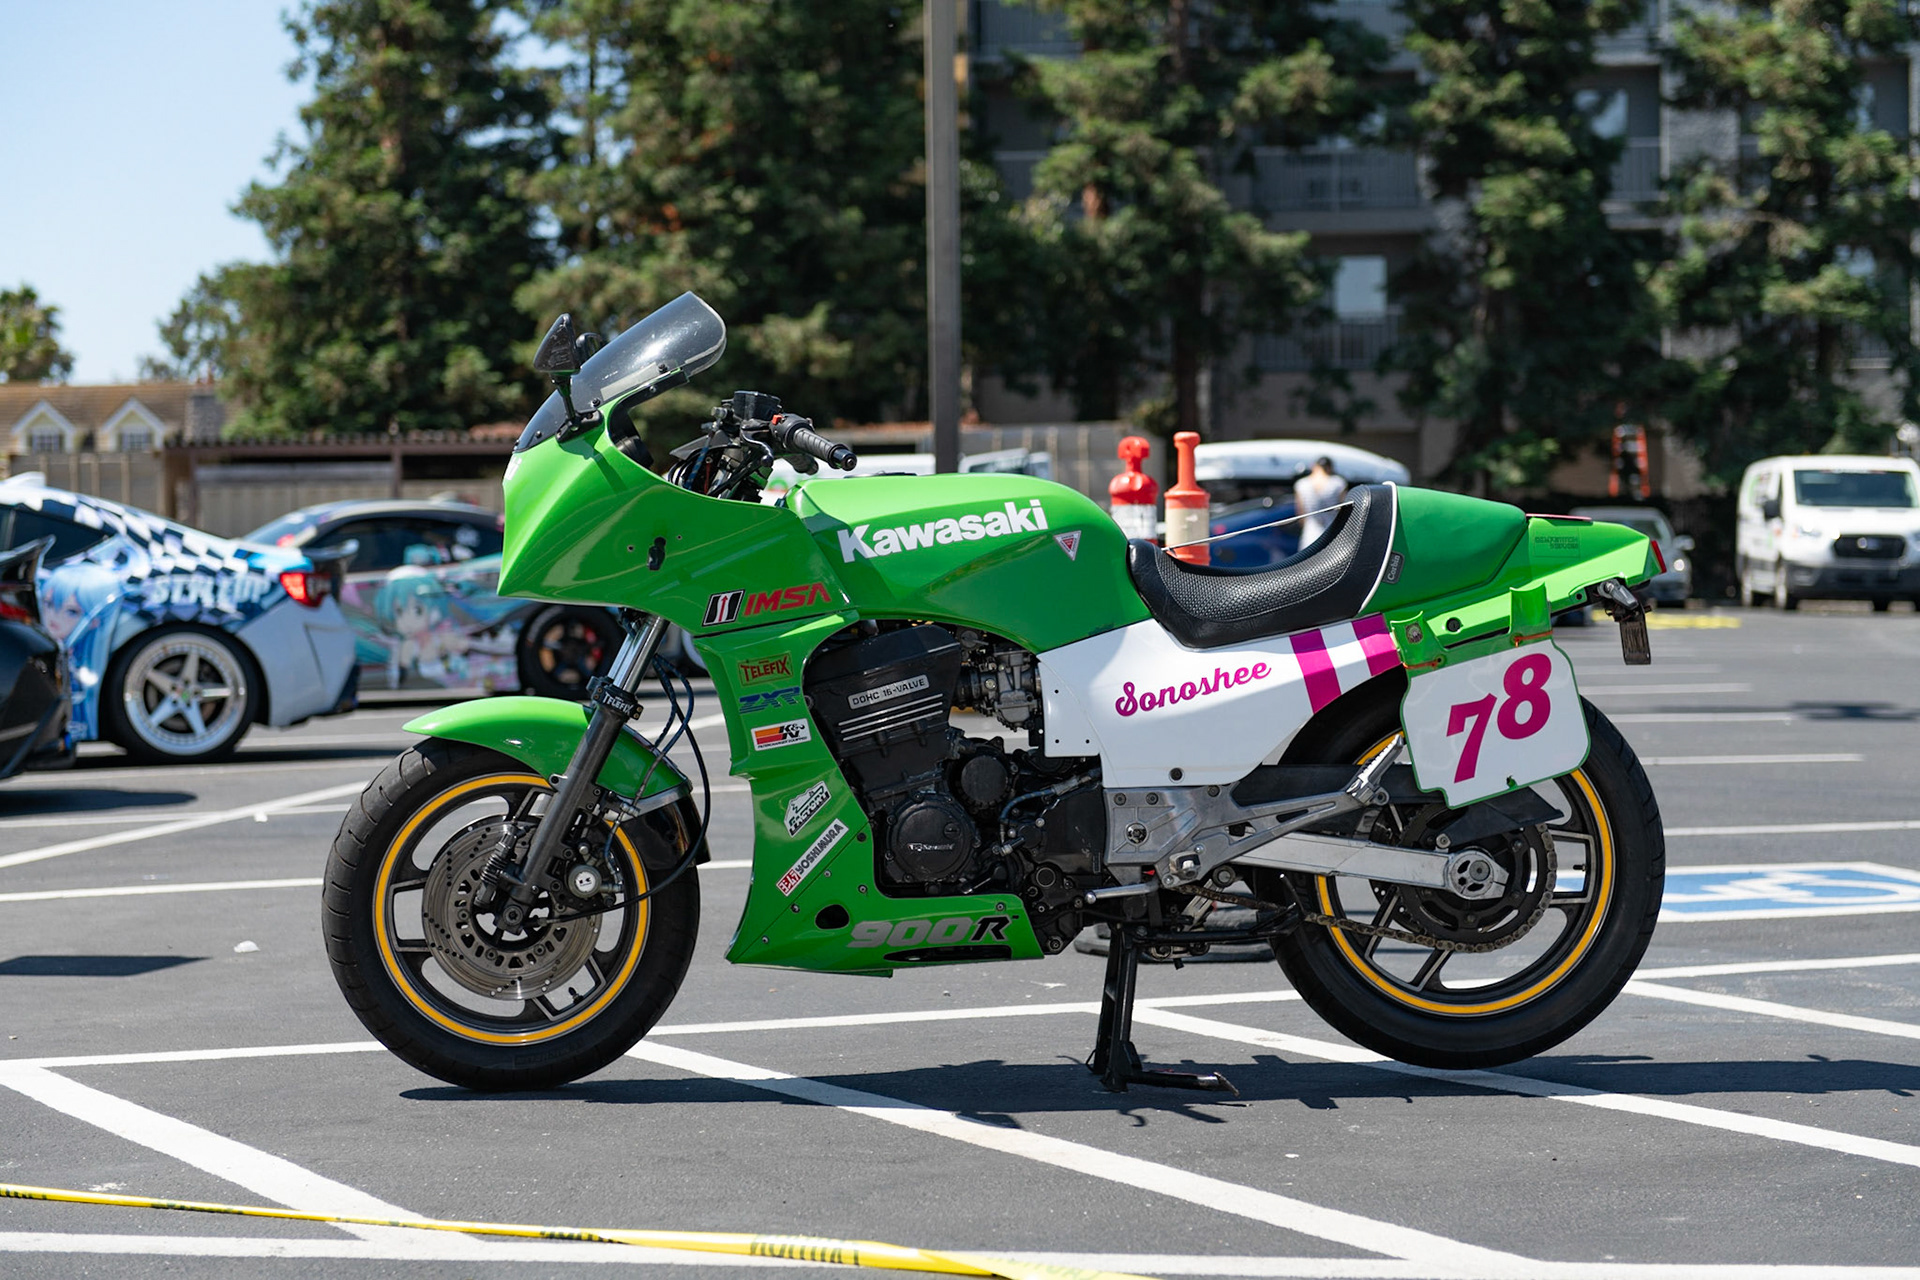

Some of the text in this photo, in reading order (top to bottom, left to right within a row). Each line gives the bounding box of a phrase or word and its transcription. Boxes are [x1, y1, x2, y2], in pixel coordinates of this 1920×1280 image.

[837, 499, 1049, 563] Kawasaki
[1387, 554, 1401, 581] Corbin
[743, 582, 832, 616] IMSA
[740, 655, 791, 683] TELEFIX
[602, 691, 634, 714] TELEFIX
[852, 678, 926, 705] DOHC 16-VALVE
[1115, 662, 1272, 717] Sonoshee
[1446, 653, 1552, 783] 78
[795, 823, 844, 875] YOSHIMURA
[846, 914, 1012, 948] 900R
